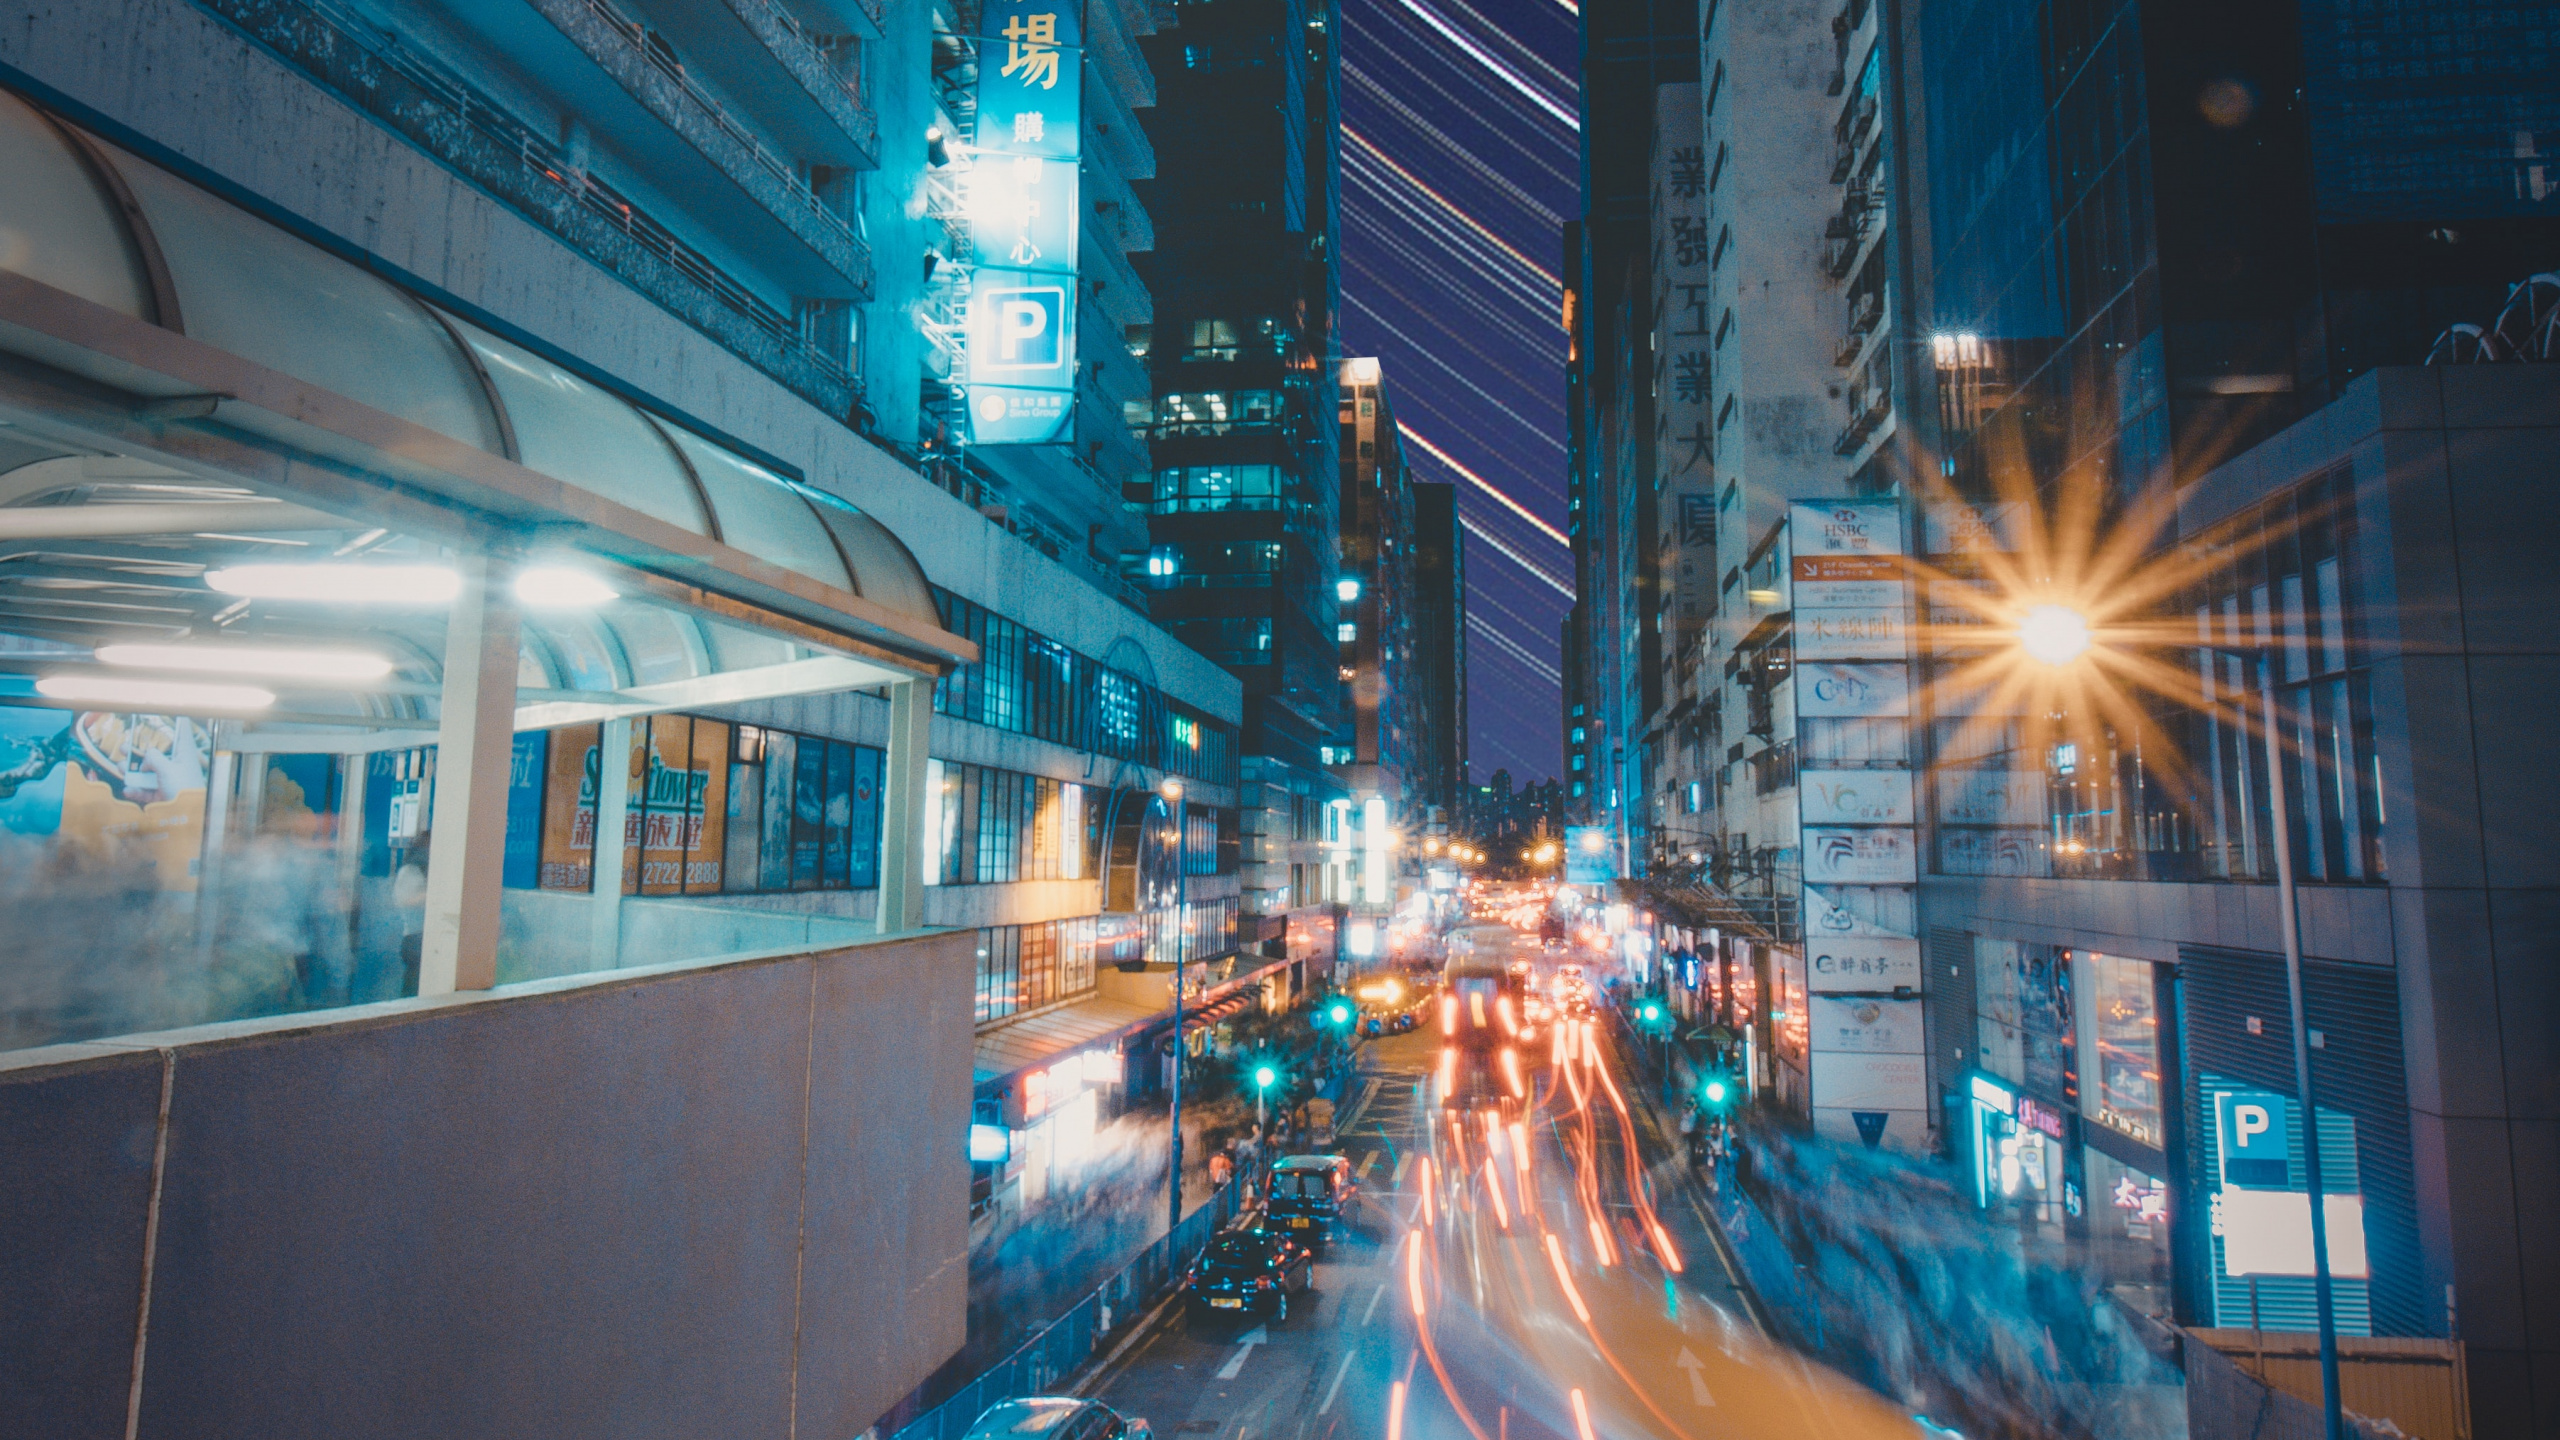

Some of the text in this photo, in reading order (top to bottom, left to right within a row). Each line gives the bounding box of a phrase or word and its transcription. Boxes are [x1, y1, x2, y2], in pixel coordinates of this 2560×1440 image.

[1001, 12, 1061, 90] 場
[1002, 302, 1047, 359] P
[1825, 524, 1868, 537] HSBC
[581, 746, 708, 805] Sflower
[642, 862, 682, 885] 2722
[685, 861, 719, 884] 2888
[2235, 1105, 2270, 1148] P
